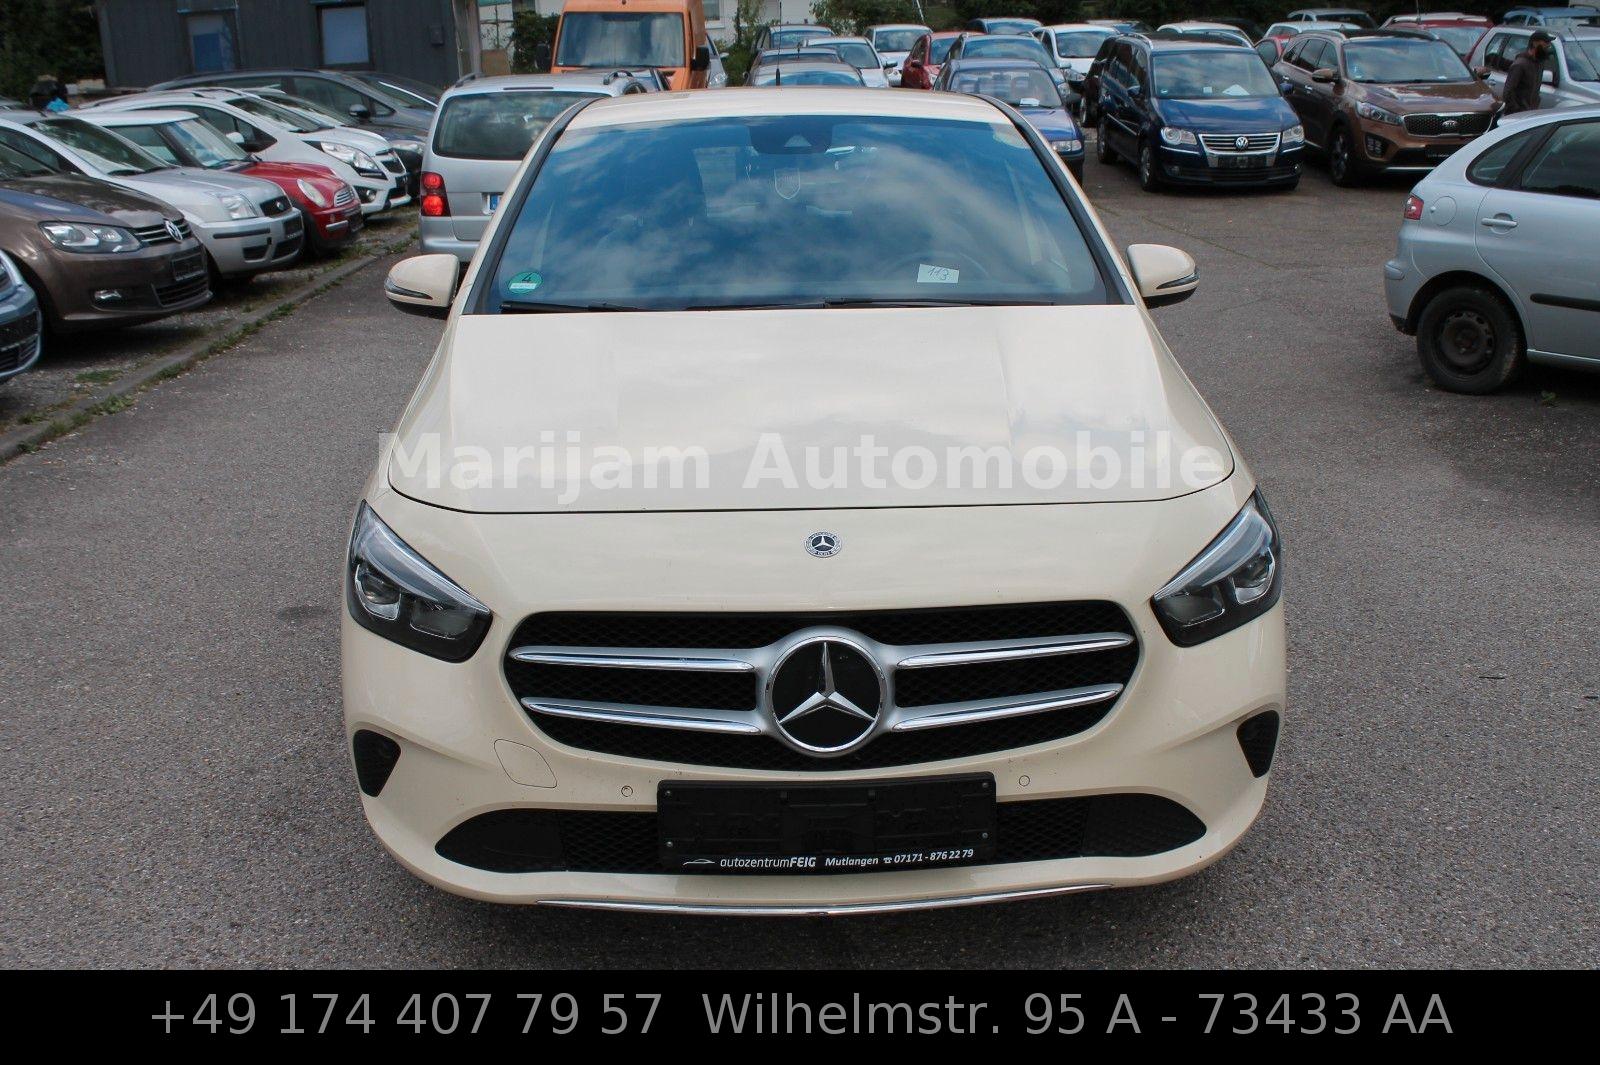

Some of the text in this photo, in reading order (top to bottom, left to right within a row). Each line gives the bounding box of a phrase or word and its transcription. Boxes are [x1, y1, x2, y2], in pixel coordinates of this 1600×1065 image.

[521, 272, 533, 283] 4
[720, 856, 817, 868] autozentrumFEIG
[825, 856, 879, 867] Mutlangen
[893, 853, 923, 864] 07171
[929, 850, 948, 861] 876
[948, 849, 961, 859] 22
[962, 848, 974, 858] 79
